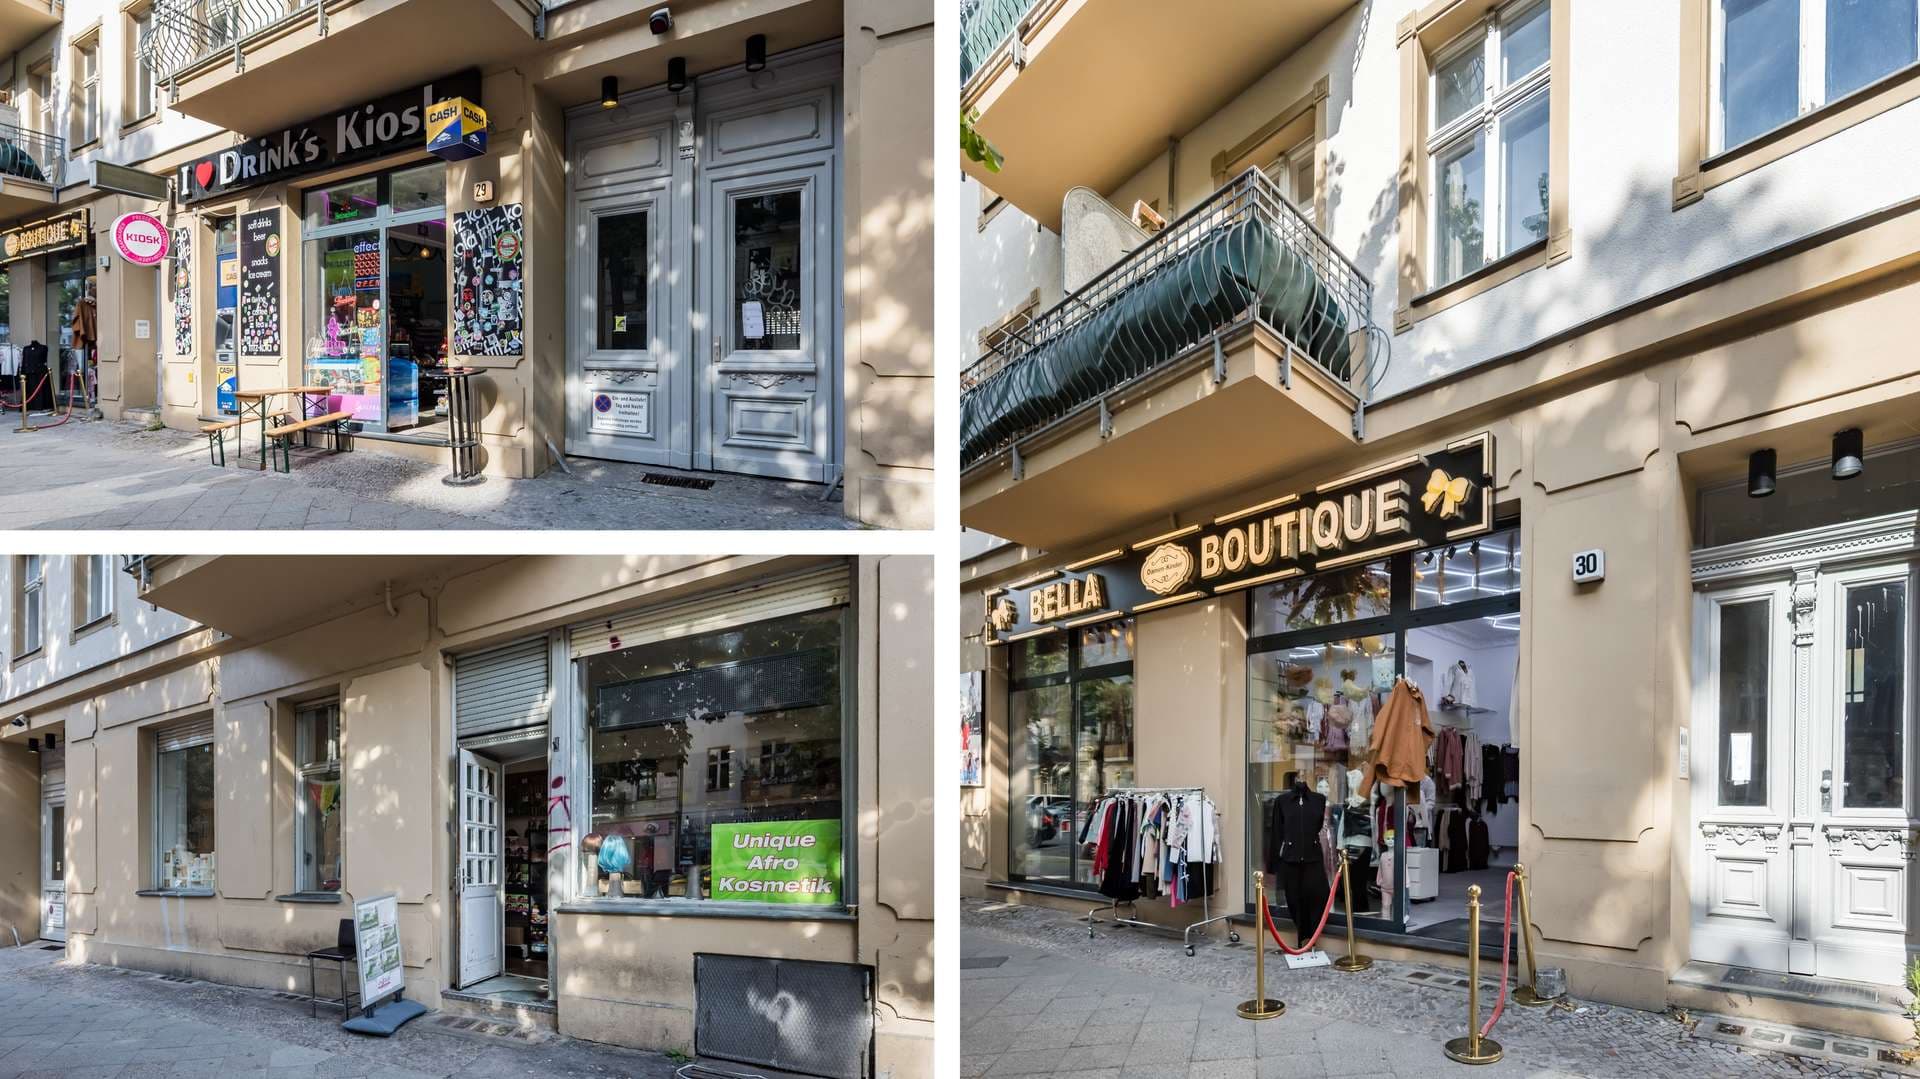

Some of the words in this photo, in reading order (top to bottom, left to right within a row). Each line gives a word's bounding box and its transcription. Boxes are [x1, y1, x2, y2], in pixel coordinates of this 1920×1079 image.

[429, 105, 458, 123] CASH
[463, 106, 485, 126] CASH
[181, 166, 192, 197] I
[475, 183, 487, 197] 29
[20, 220, 69, 250] BOUTIQUE
[126, 233, 160, 244] KIOSK
[253, 232, 266, 242] beer
[251, 256, 268, 266] snacks
[1029, 573, 1104, 624] BELLA
[1201, 479, 1411, 580] BOUTIQUE
[1575, 553, 1597, 576] 30
[733, 832, 816, 851] Unique
[746, 855, 799, 870] Afro
[718, 876, 833, 894] Kosmetik
